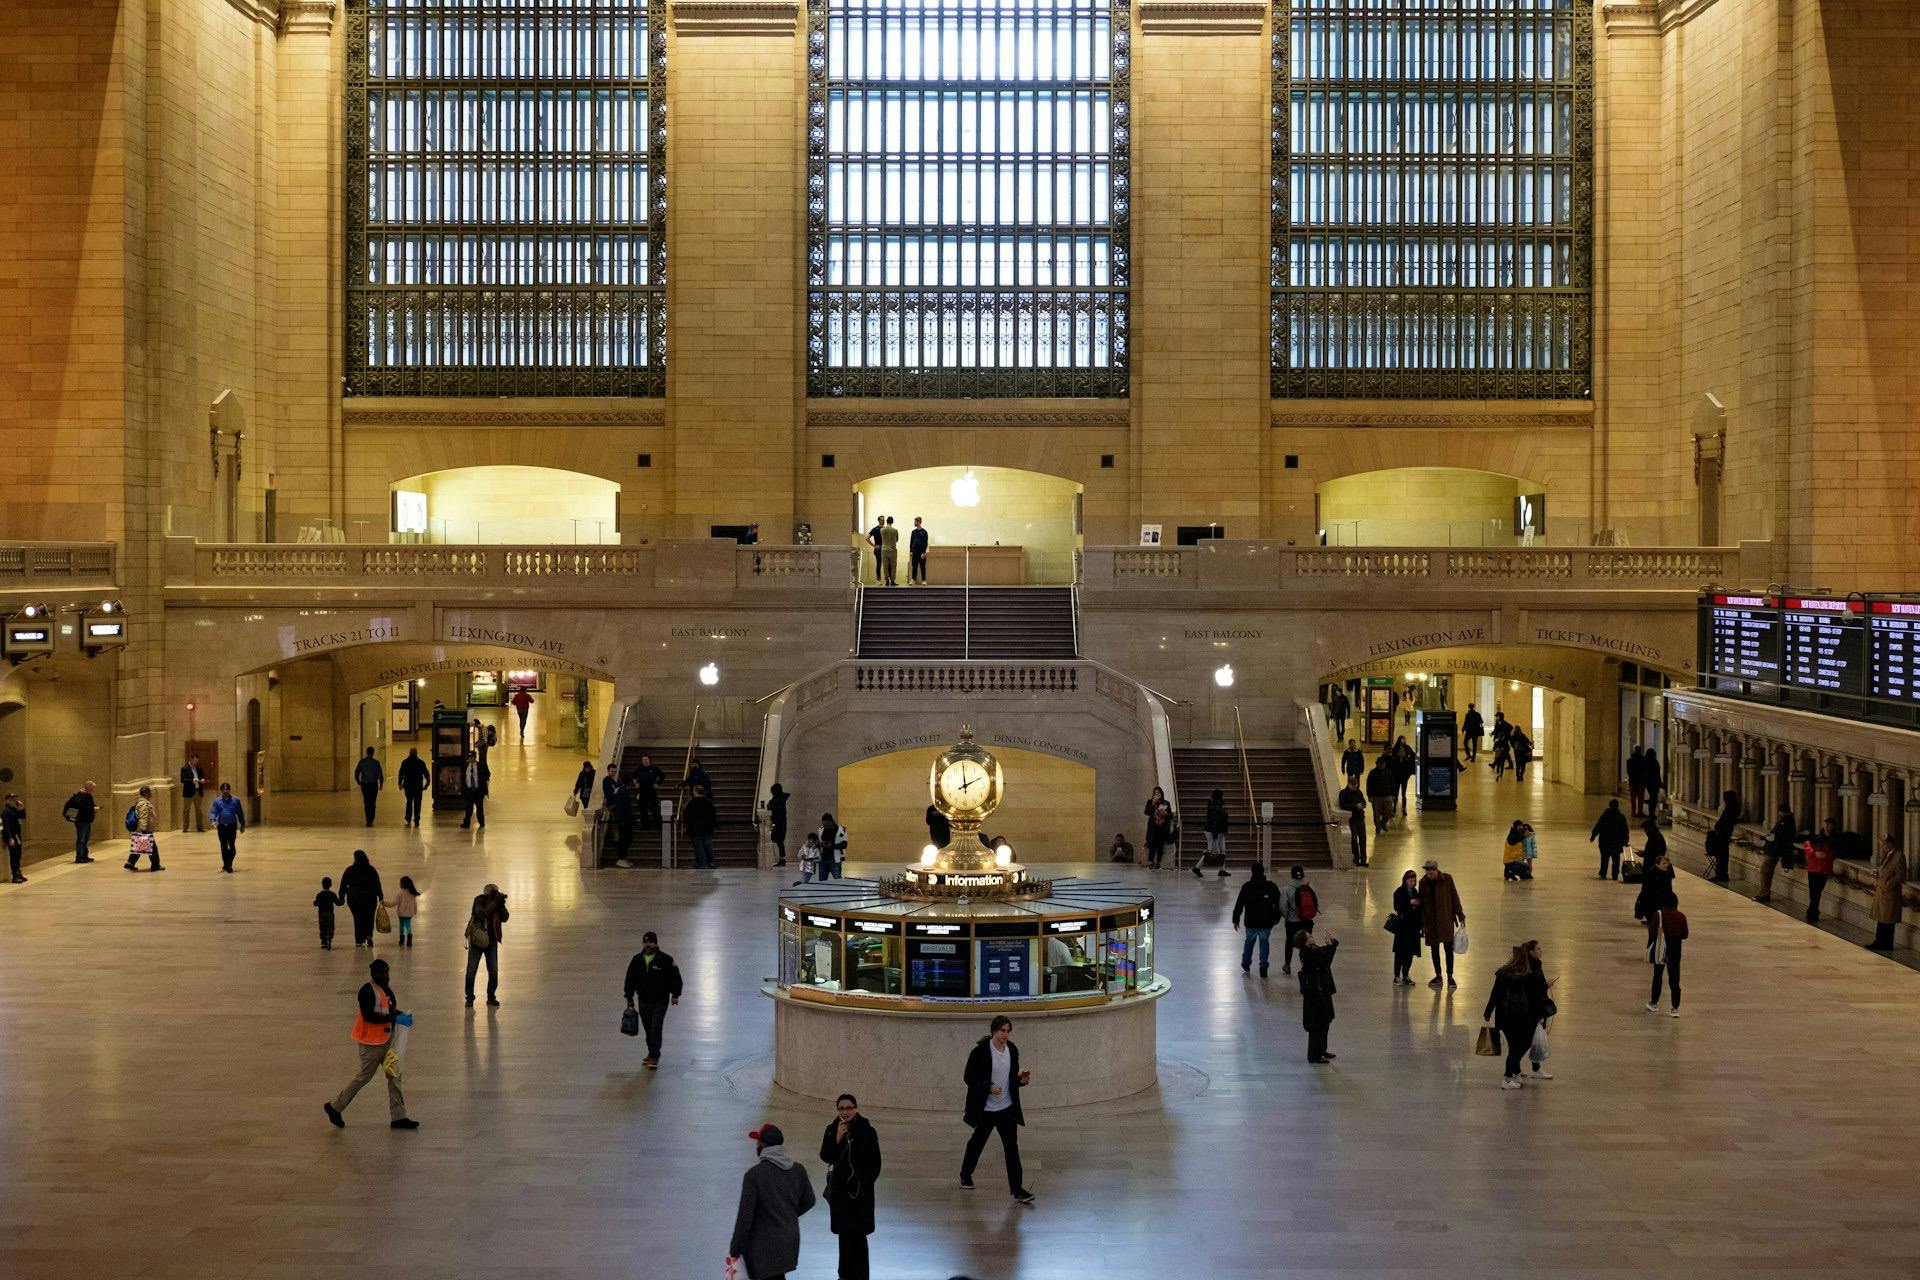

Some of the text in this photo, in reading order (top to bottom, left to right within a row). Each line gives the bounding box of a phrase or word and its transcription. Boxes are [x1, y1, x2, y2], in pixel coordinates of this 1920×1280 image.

[293, 631, 347, 653] TRACKS
[350, 630, 363, 642] 21
[367, 627, 386, 640] TO
[451, 626, 566, 654] LEXINGTON AVE
[671, 628, 750, 637] EAST BALCONY
[1184, 629, 1264, 639] EAST BALCONY
[1368, 628, 1485, 656] LEXINGTON AVE
[1535, 628, 1661, 660] TICKET MACHINES
[411, 659, 452, 674] STREET
[457, 656, 506, 668] PASSAGE
[517, 656, 566, 670] SUBWAY
[1389, 659, 1442, 671] PASSAGE
[1447, 659, 1501, 673] SUBWAY
[861, 740, 897, 755] TRACKS
[993, 735, 1090, 761] DINING CONCOURSE
[945, 874, 1004, 887] Information
